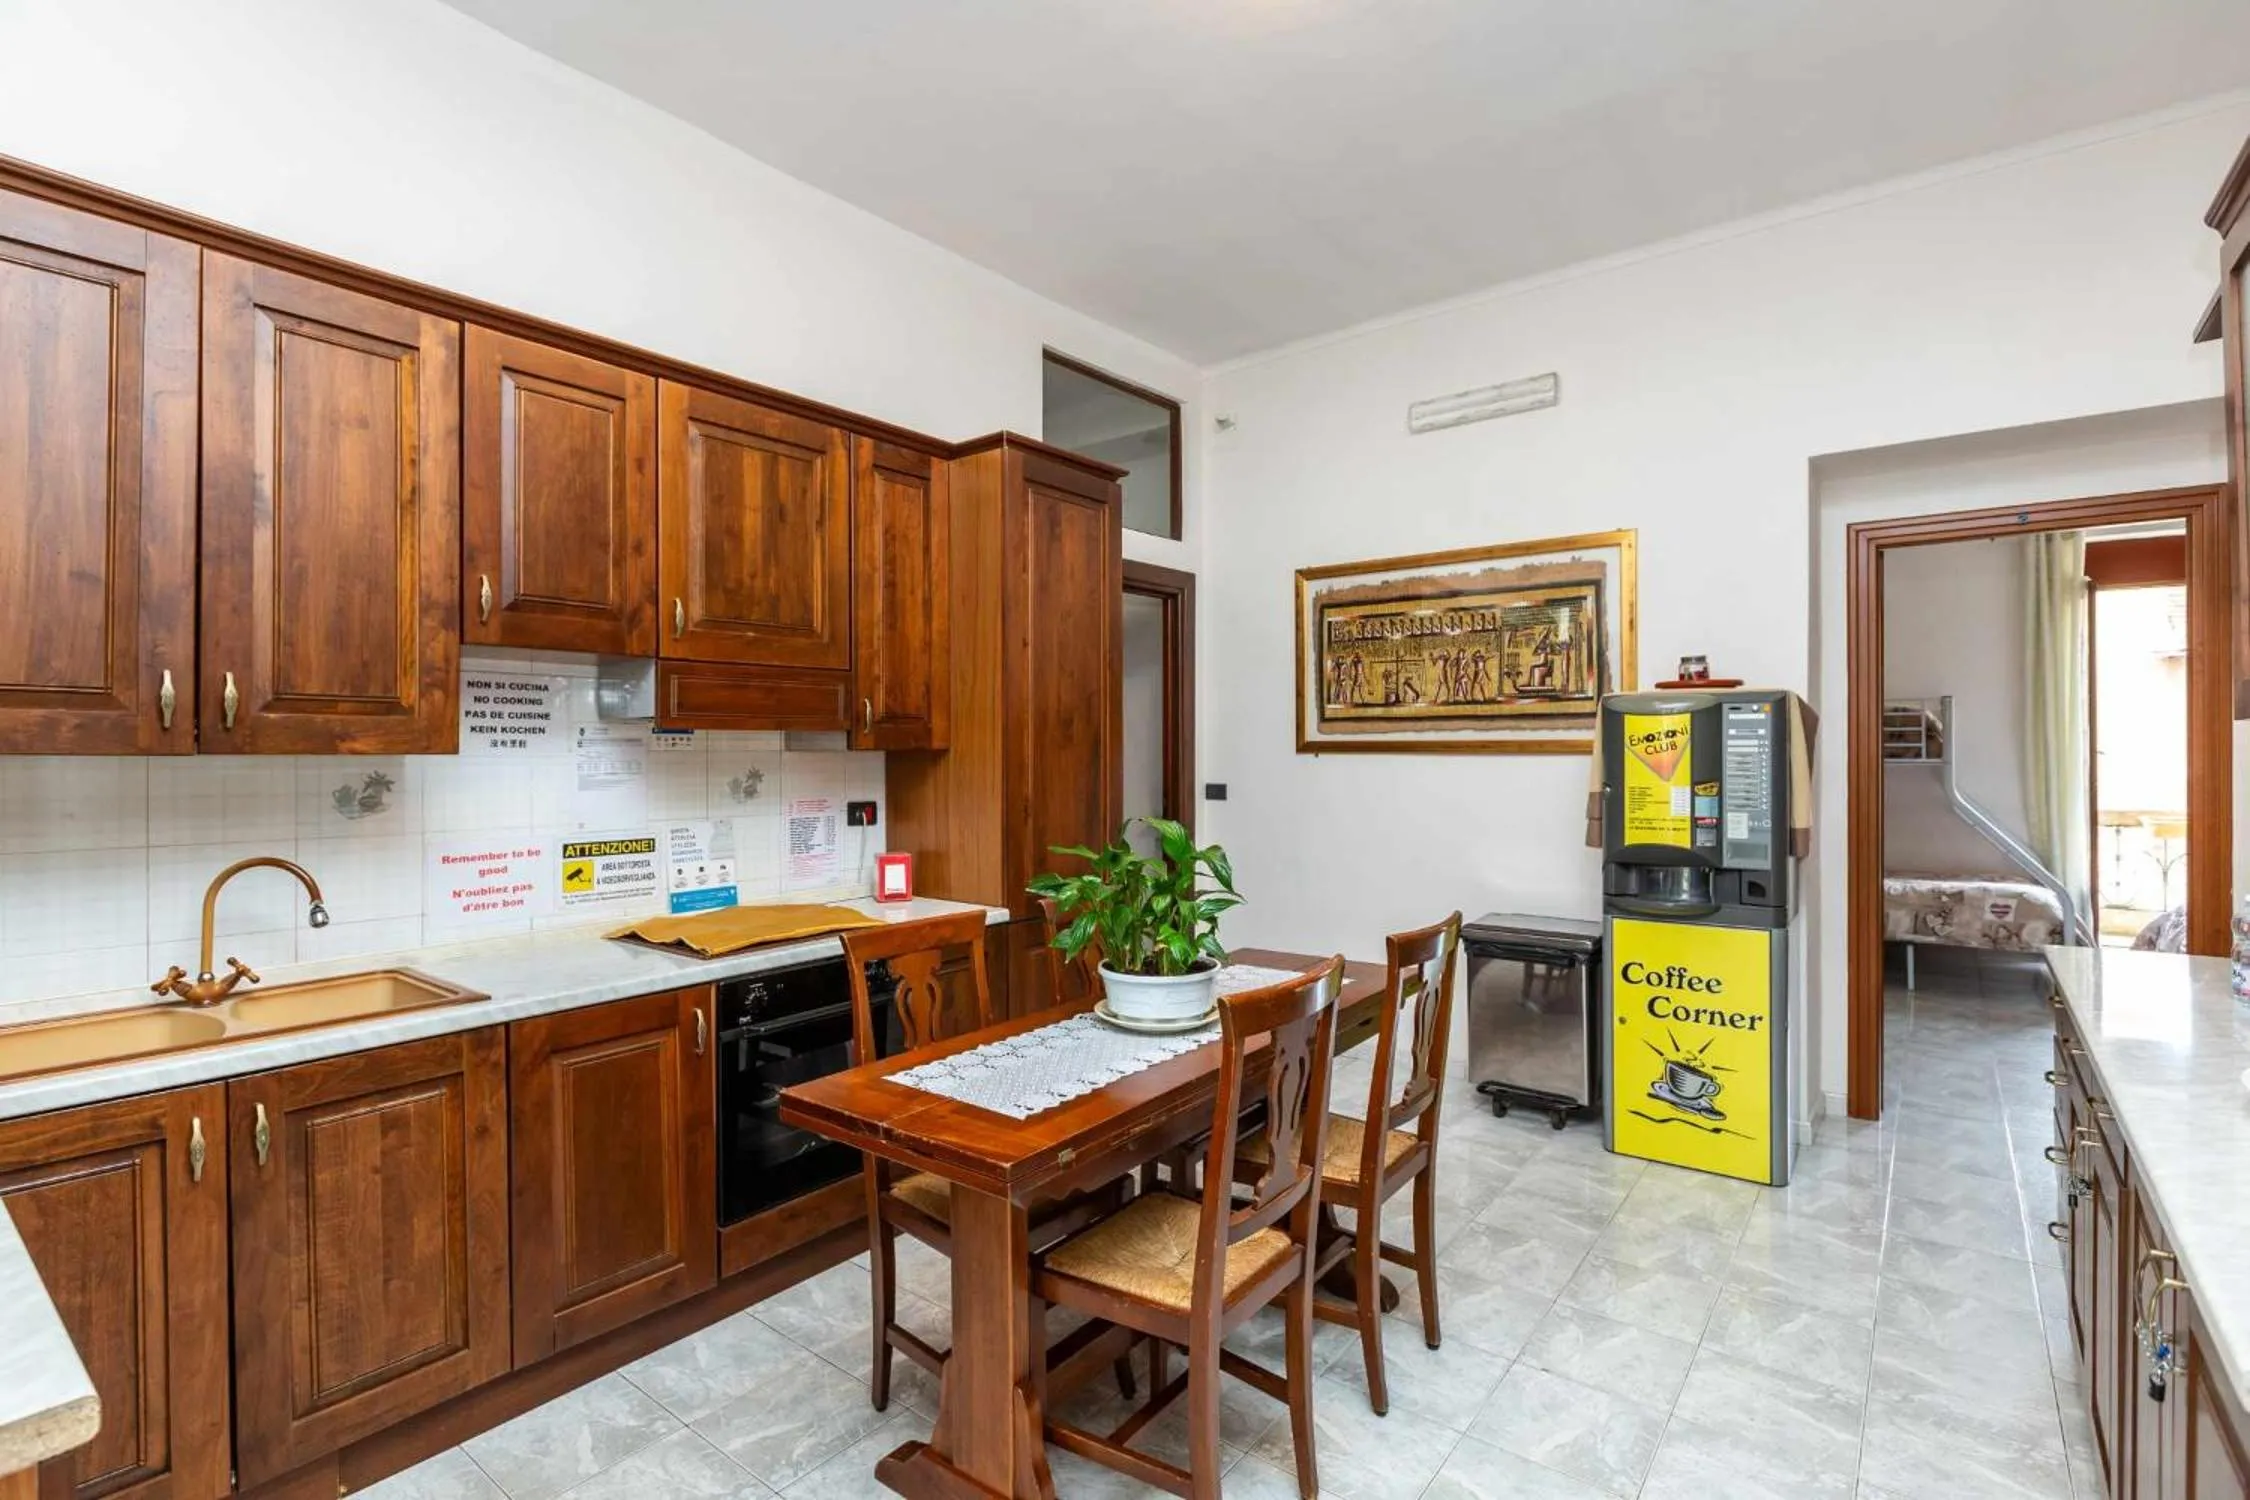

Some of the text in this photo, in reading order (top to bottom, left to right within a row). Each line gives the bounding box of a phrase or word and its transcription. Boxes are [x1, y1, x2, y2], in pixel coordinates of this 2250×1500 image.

[467, 680, 549, 692] NON SI CUCINA
[473, 695, 543, 706] NO COOKING
[465, 710, 551, 721] PAS DE CUISINE
[470, 725, 546, 735] KEIN KOCHEN
[1645, 740, 1678, 755] CLUB
[565, 839, 654, 857] ATTENZIONE!
[442, 849, 541, 864] Remember to be
[478, 866, 508, 878] good
[452, 883, 533, 898] N'oubliez pas
[503, 899, 524, 908] bon
[1621, 962, 1723, 994] Coffee
[1647, 995, 1763, 1031] Corner
